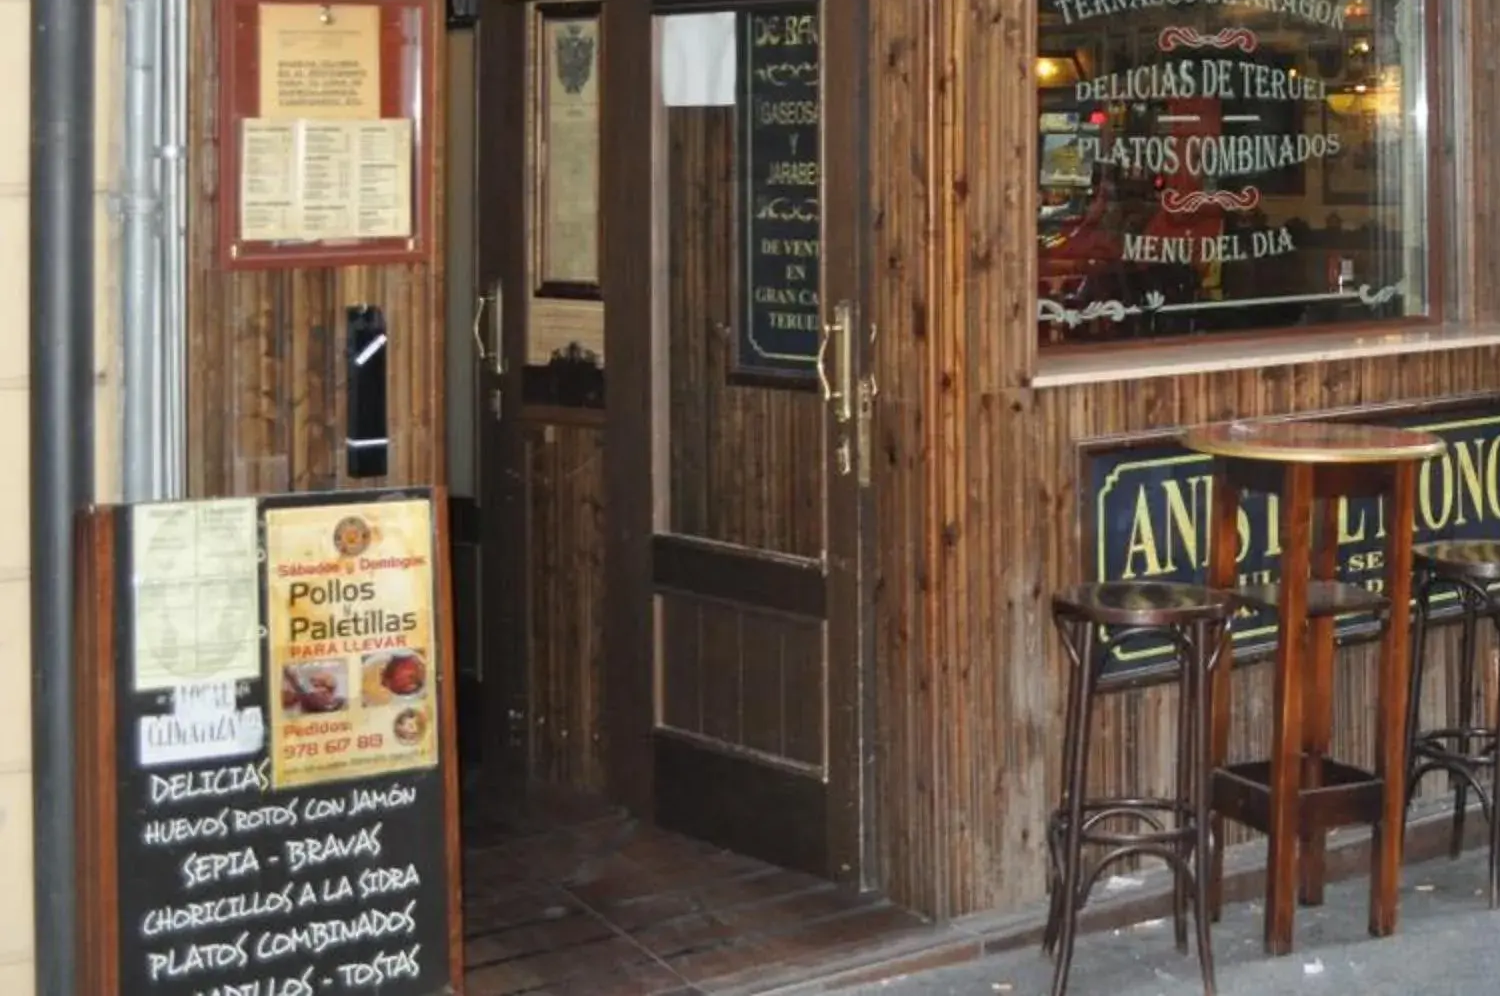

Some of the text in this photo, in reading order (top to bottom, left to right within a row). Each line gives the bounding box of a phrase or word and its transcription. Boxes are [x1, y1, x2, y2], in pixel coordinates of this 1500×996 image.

[1076, 60, 1197, 103] DELICIAS
[1202, 60, 1233, 99] DE
[1077, 133, 1340, 177] PLATOS COMBINADOS
[1201, 234, 1247, 261] DEL
[288, 579, 375, 606] Pollos
[289, 610, 417, 642] Paletillas
[290, 635, 407, 658] PARA LLEVAR
[151, 759, 270, 802] DELICIAS
[144, 808, 228, 844] HUEVOS
[235, 798, 298, 831] ROTOS
[304, 796, 344, 820] CON
[183, 848, 259, 888] SEPIA
[285, 823, 383, 871] BRAVAS
[143, 864, 420, 934] CHORICILLOS A LA SIDRA
[148, 900, 416, 980] PLATOS COMBINADOS
[339, 944, 420, 986] TOSTAS
